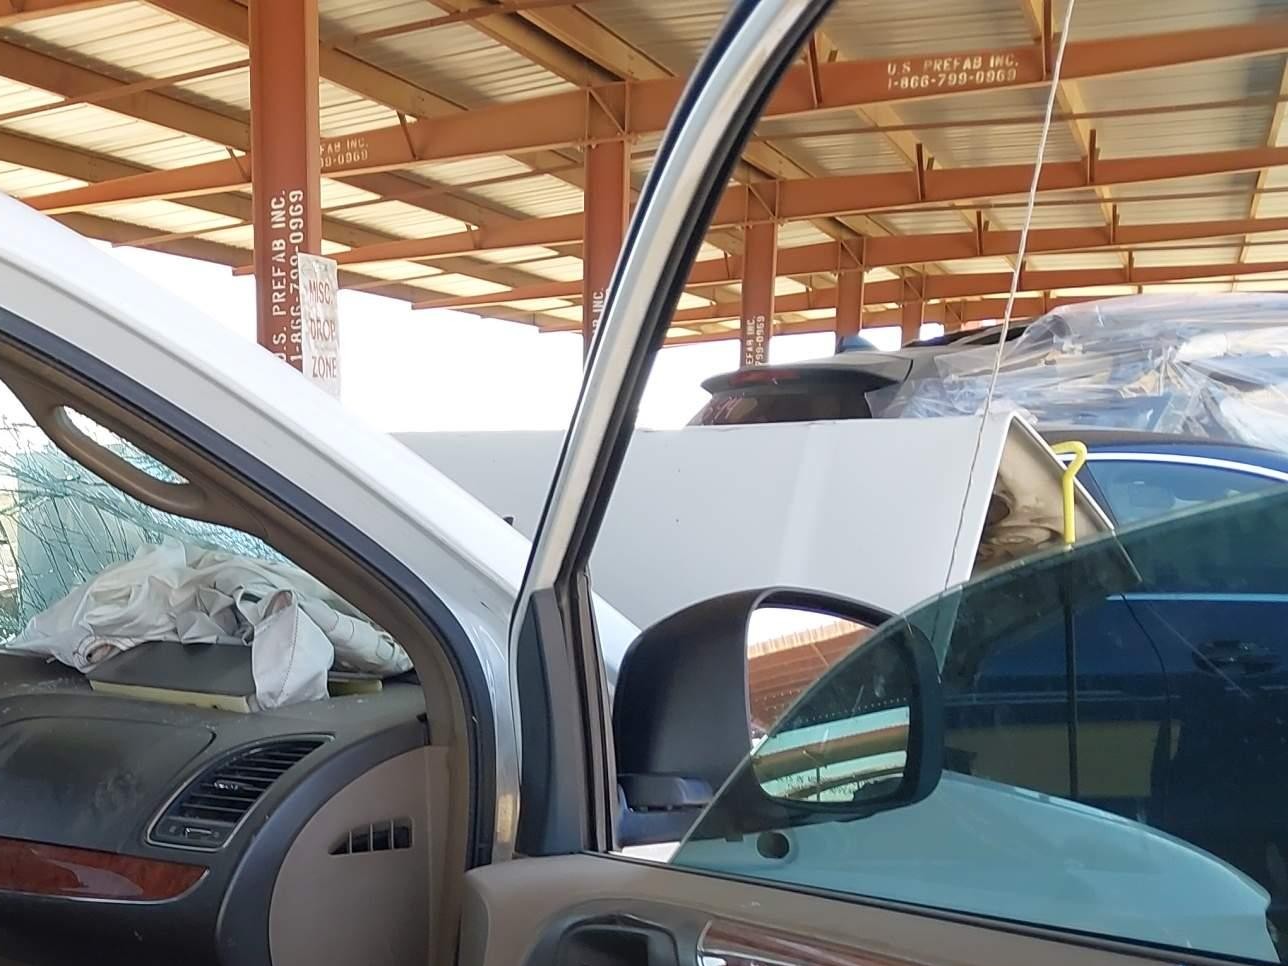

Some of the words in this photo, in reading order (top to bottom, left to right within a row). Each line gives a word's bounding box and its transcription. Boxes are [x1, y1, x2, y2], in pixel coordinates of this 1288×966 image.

[923, 55, 983, 72] PREFAB
[989, 53, 1019, 68] INC.
[887, 68, 1017, 91] 1-866-799-0969
[271, 189, 286, 228] INC.
[271, 239, 287, 316] PREFAB
[310, 319, 336, 341] DROP
[312, 355, 337, 378] ZONE
